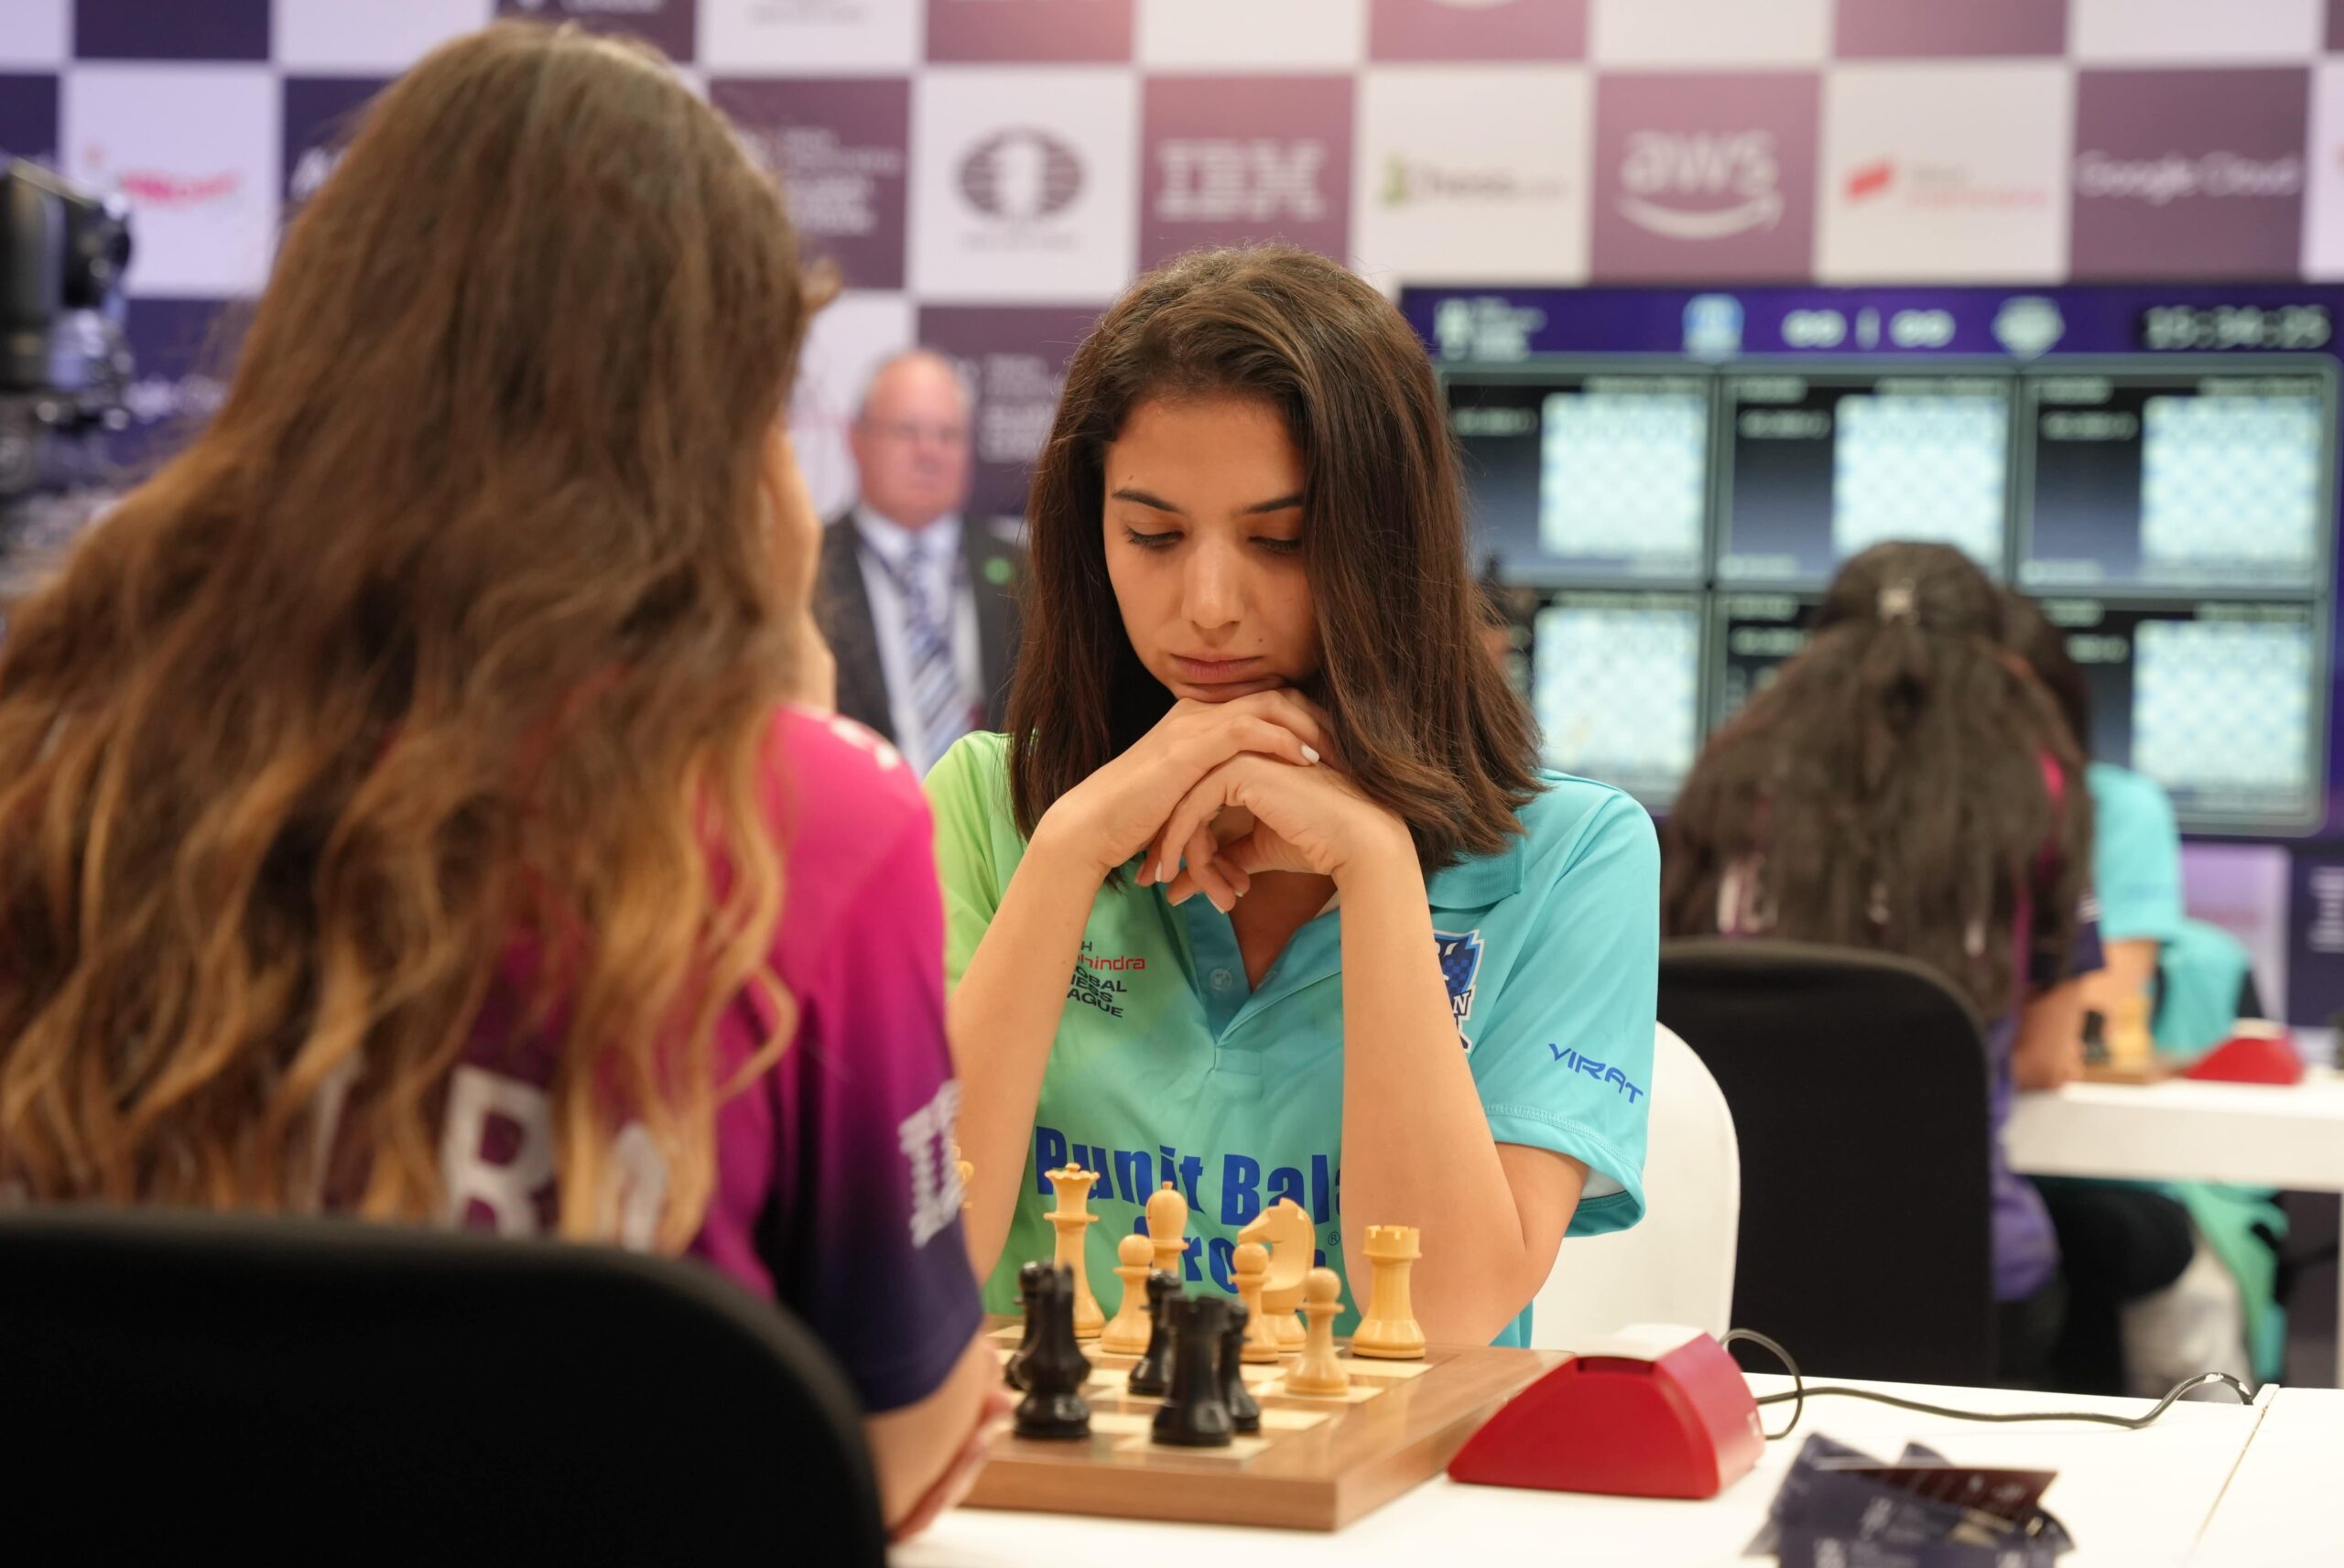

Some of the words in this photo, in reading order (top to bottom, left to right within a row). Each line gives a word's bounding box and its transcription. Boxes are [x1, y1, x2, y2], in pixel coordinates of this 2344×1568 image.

[1154, 138, 1328, 223] IBM
[1619, 126, 1782, 196] aws
[2076, 149, 2199, 206] Google
[1074, 965, 1128, 993] OBAL
[1078, 953, 1146, 971] hindra
[1067, 988, 1124, 1019] AGUE
[1547, 1043, 1644, 1105] VIRAT
[1036, 1125, 1205, 1215] Punit
[1221, 1153, 1341, 1227] Bal
